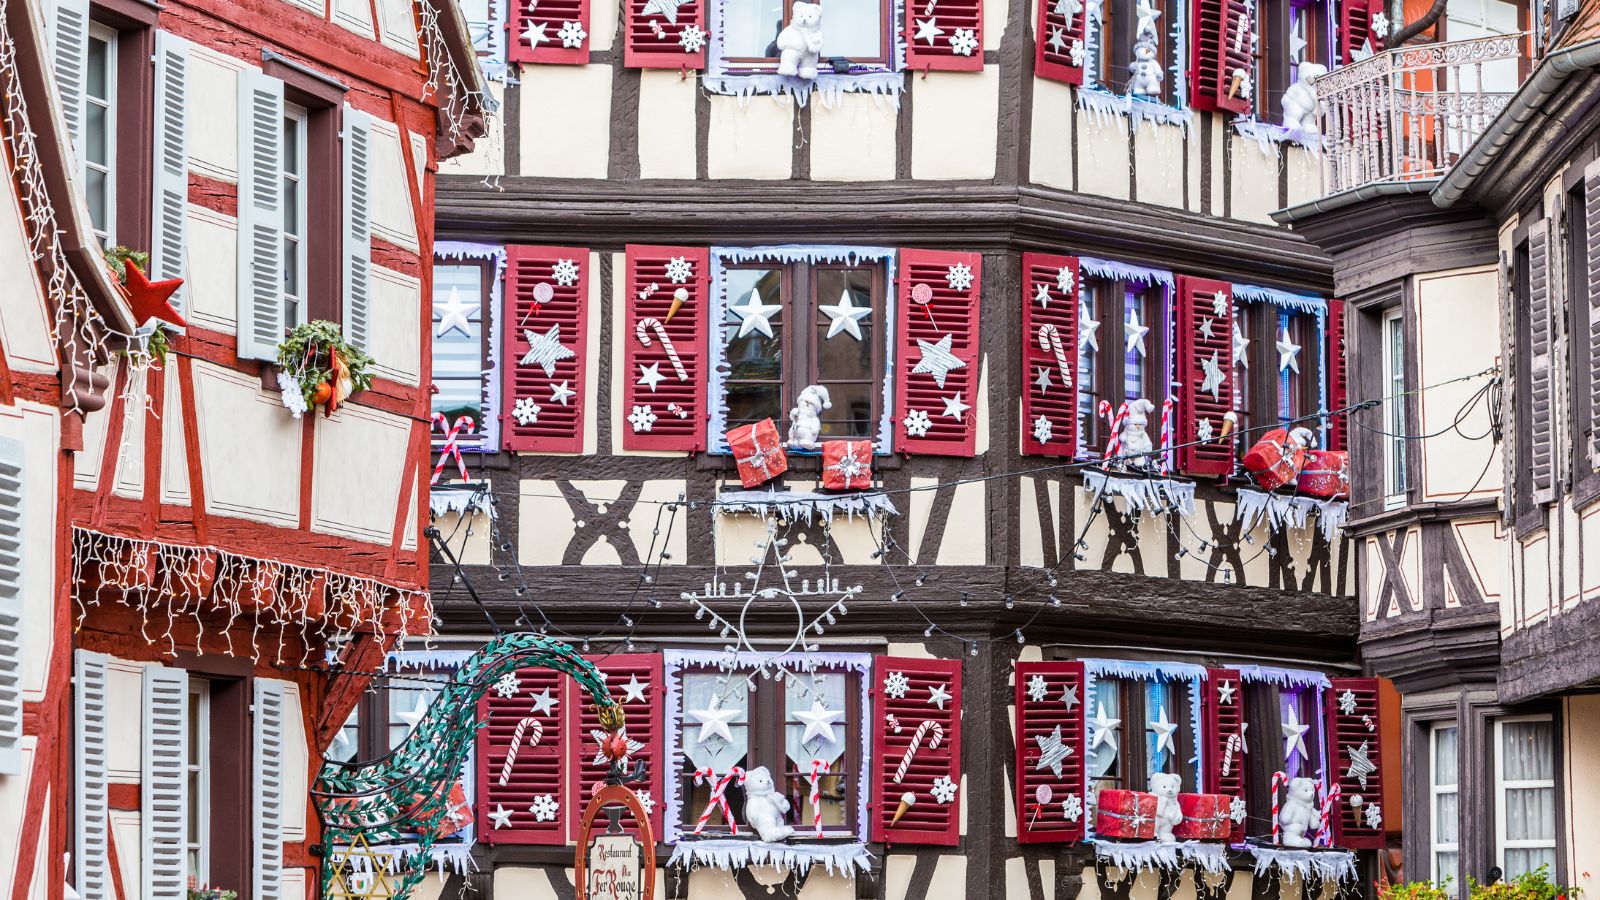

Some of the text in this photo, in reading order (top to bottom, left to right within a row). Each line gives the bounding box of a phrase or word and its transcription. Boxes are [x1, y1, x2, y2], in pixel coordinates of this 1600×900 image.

[598, 843, 632, 861] Restaurant
[592, 869, 635, 900] Fer Rouge
